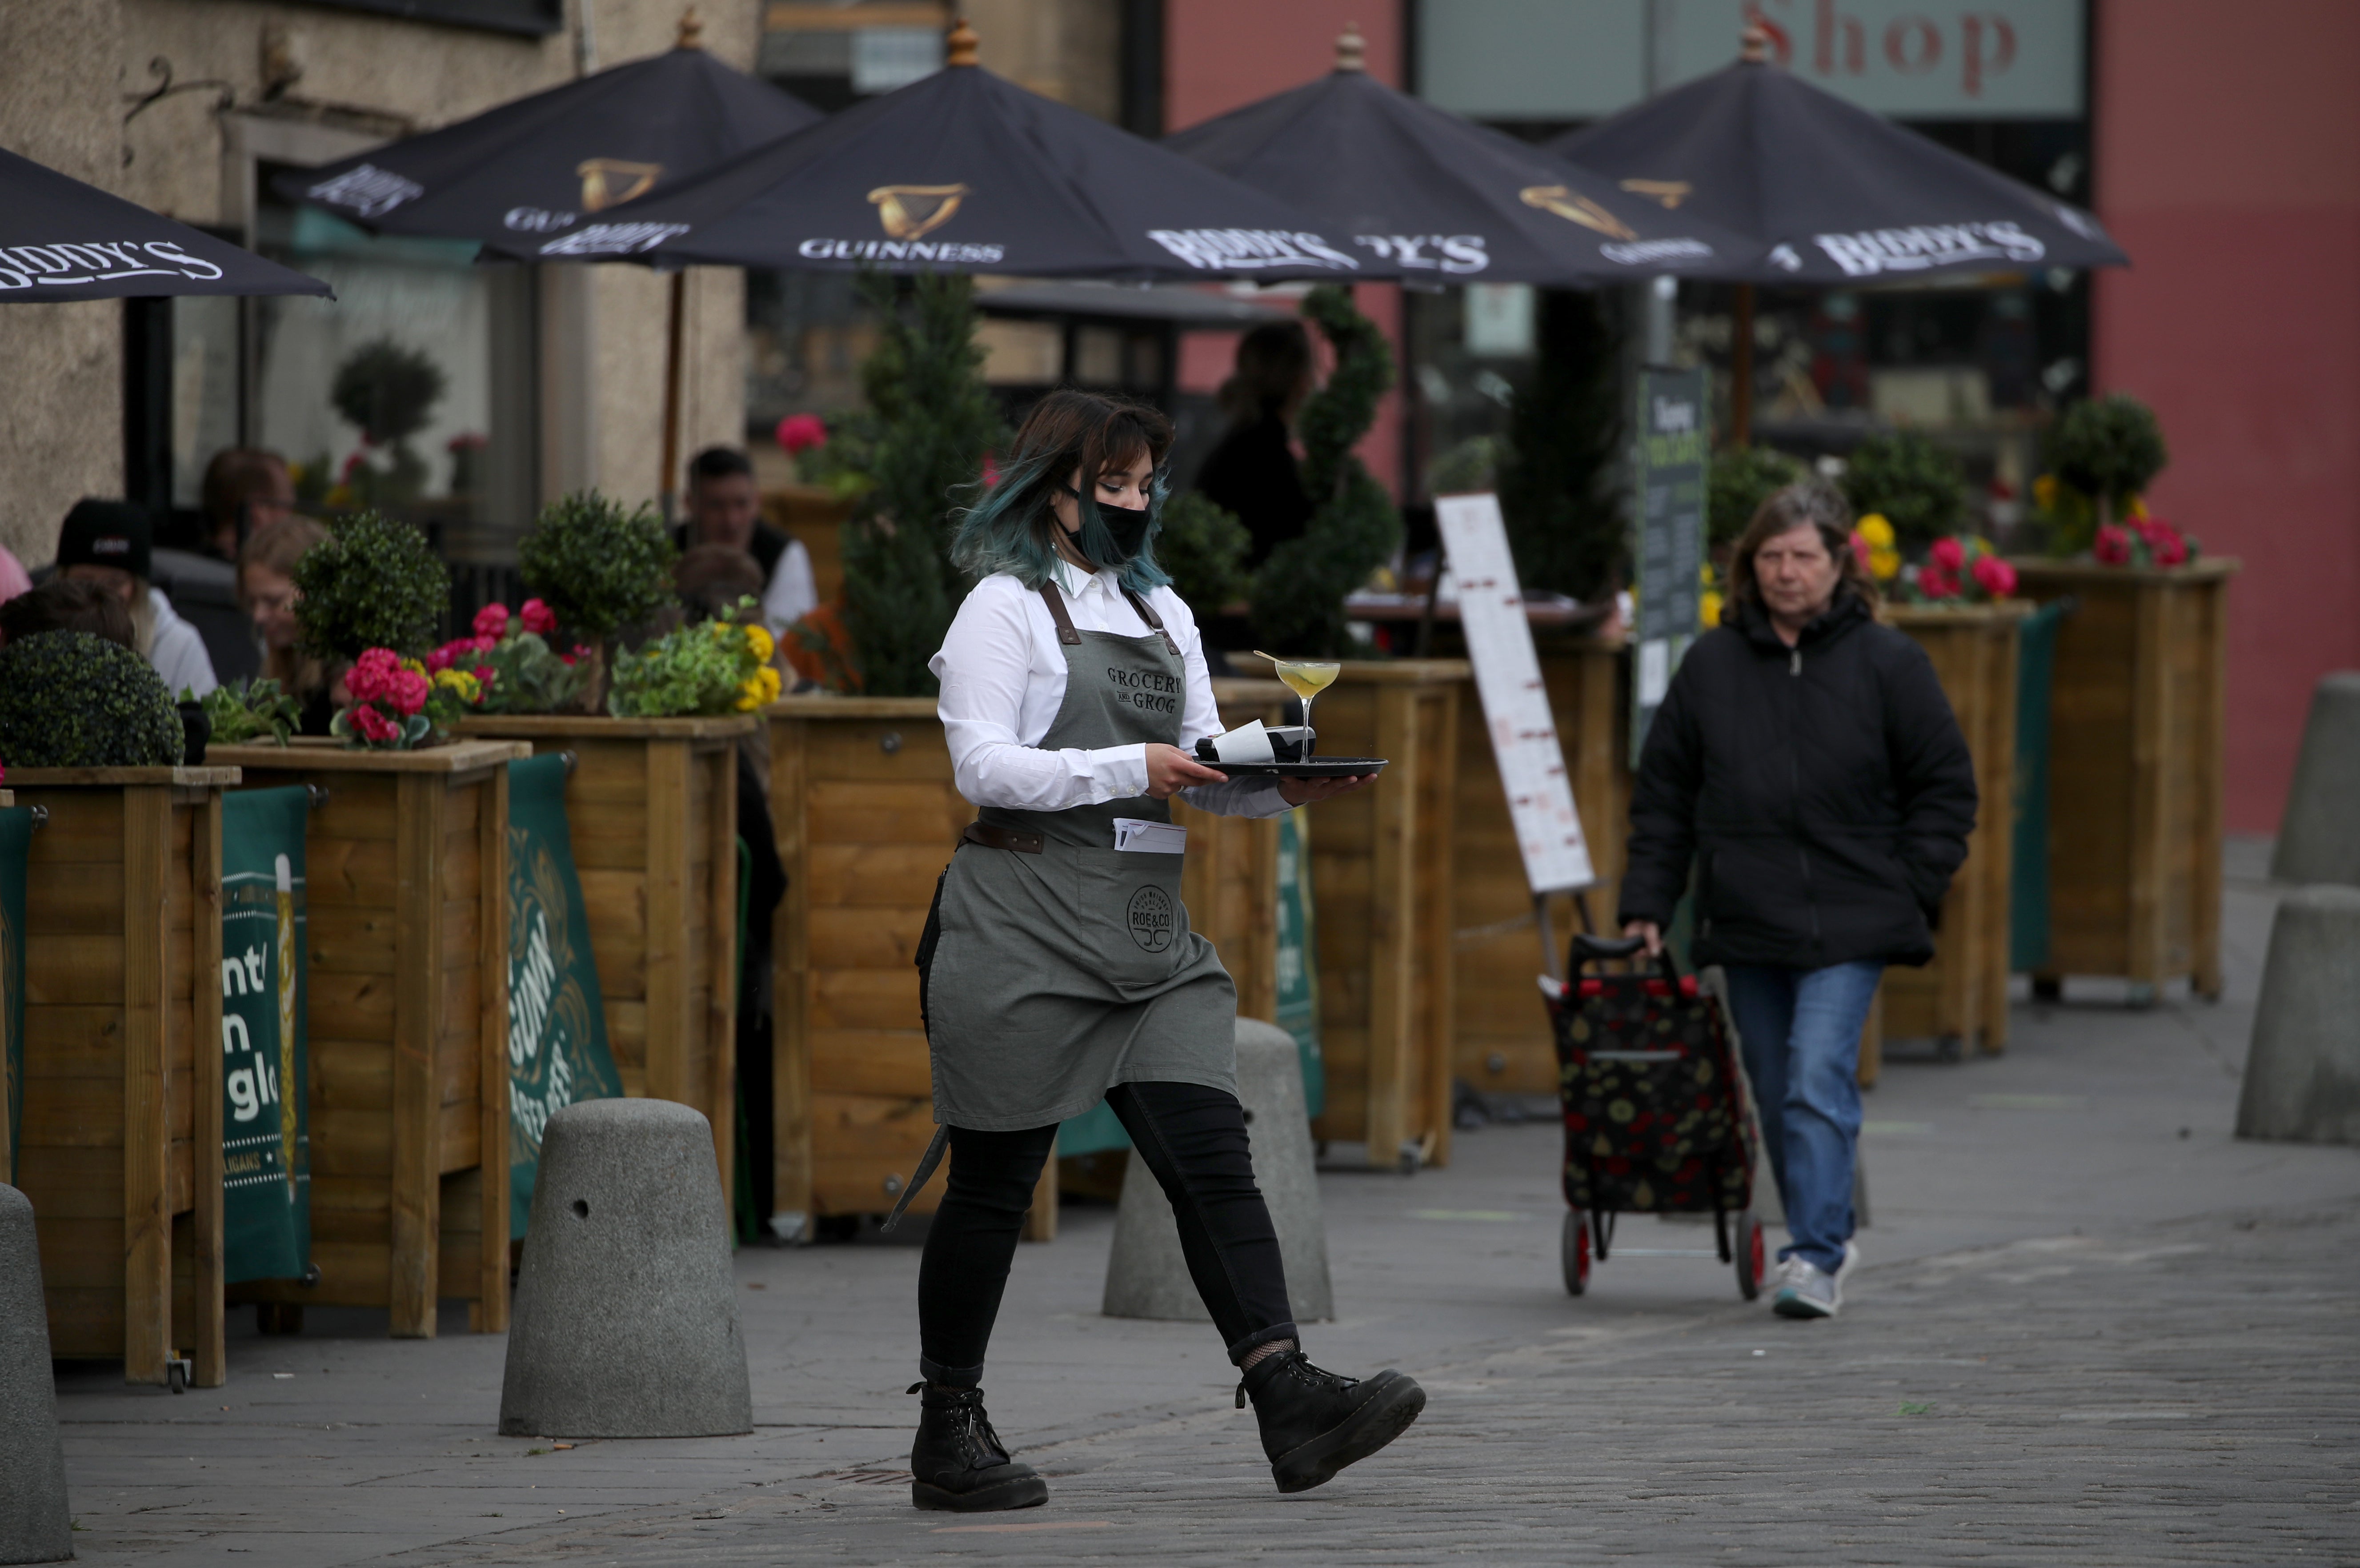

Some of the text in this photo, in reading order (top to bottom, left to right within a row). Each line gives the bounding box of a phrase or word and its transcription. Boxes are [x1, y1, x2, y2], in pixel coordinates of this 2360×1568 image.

[799, 238, 1005, 264] GUINNESS
[1107, 667, 1181, 694] GROCERY
[1118, 692, 1176, 714] AND GROG
[1134, 891, 1169, 911] IRISH WHISKEY
